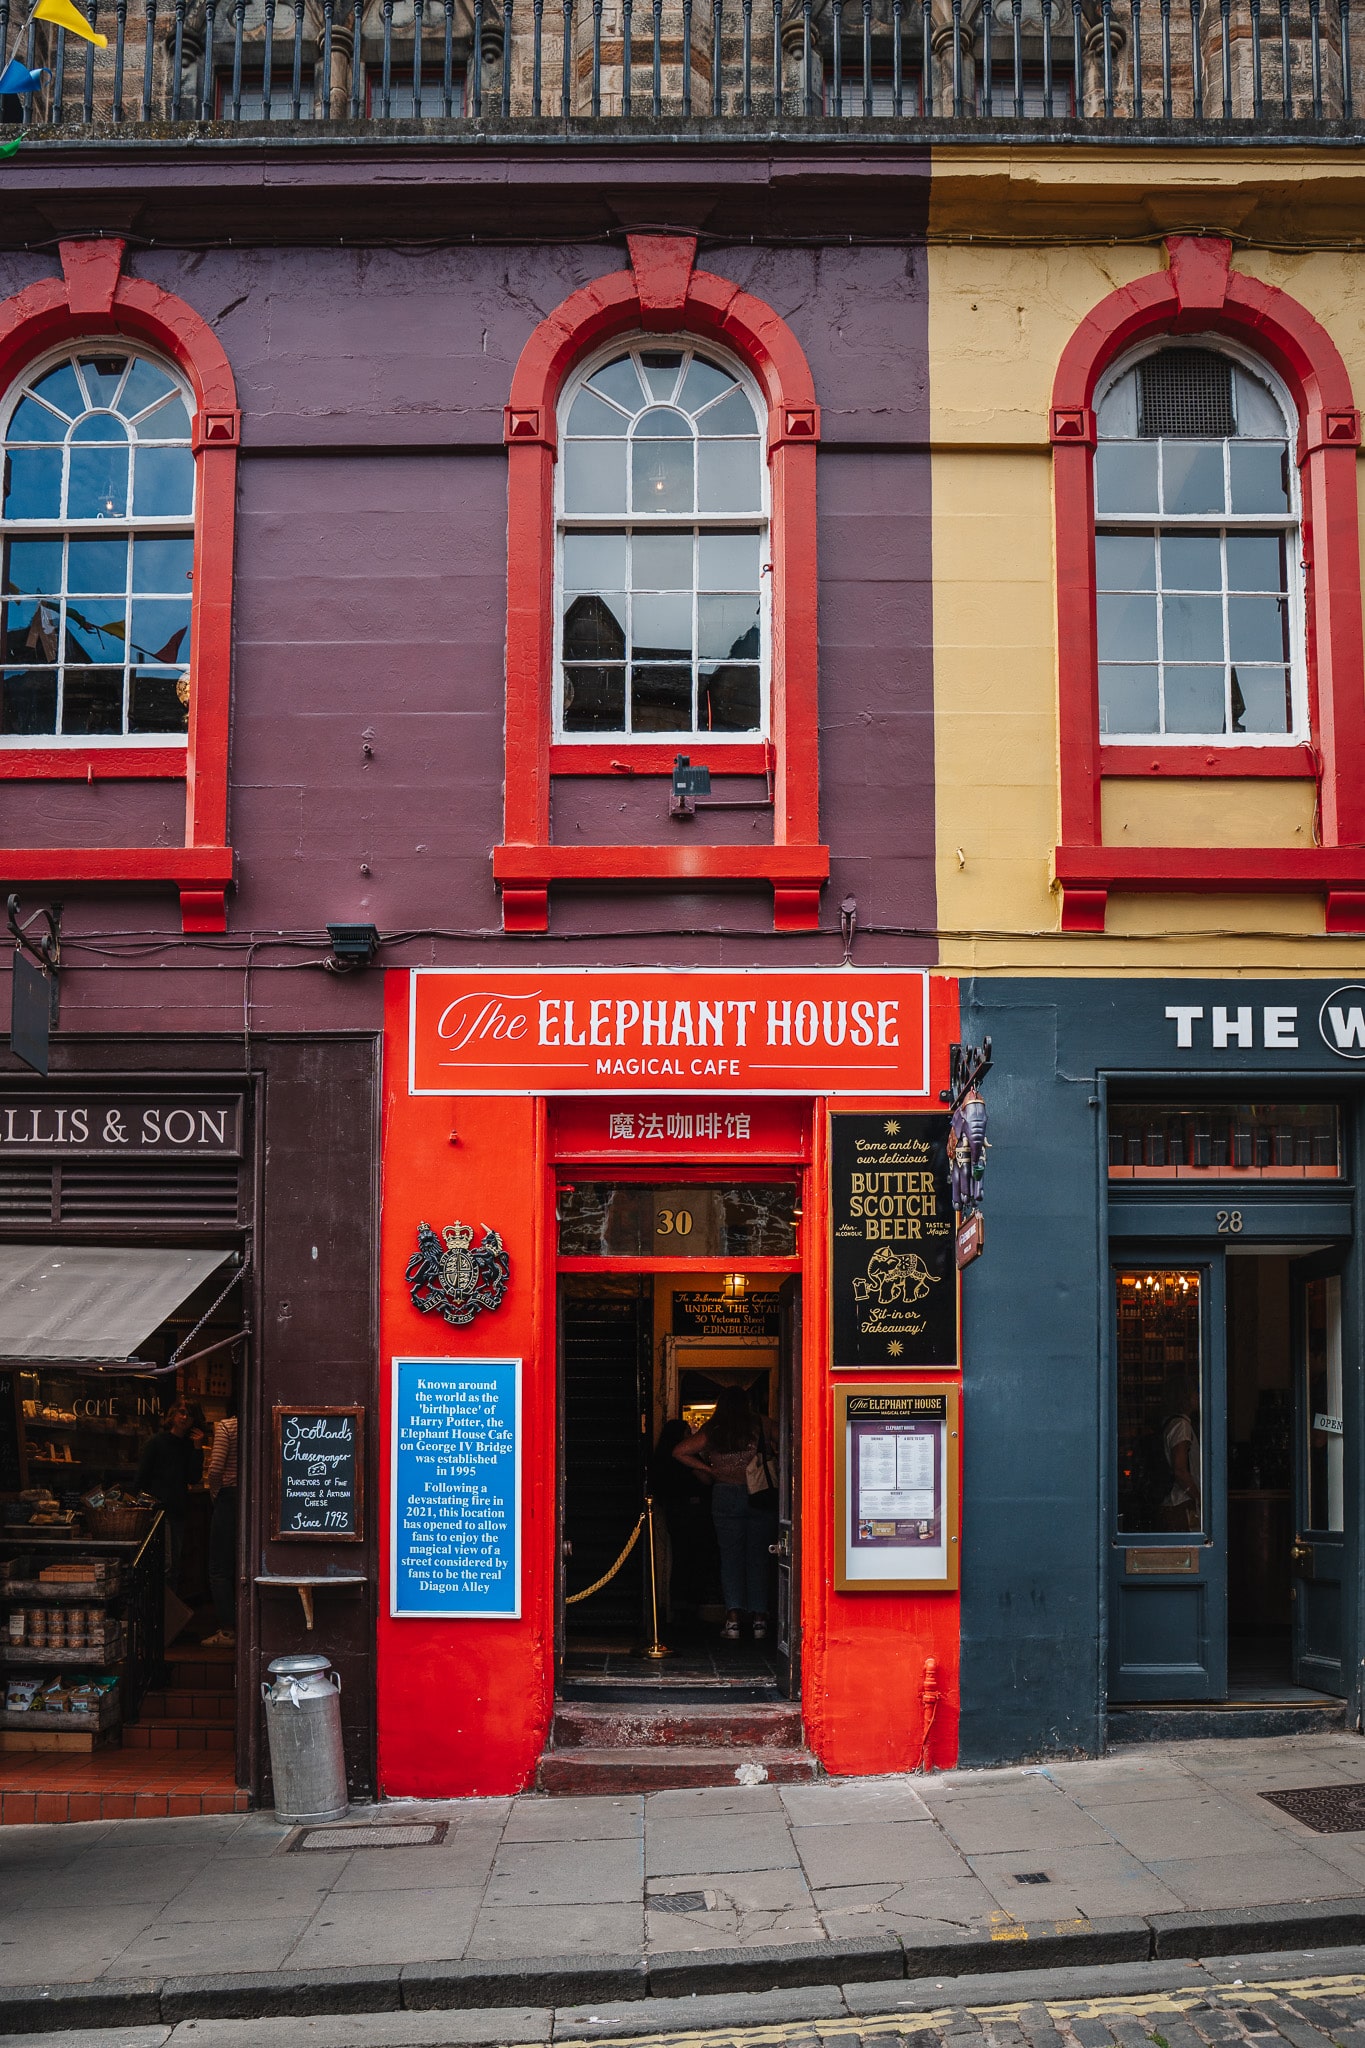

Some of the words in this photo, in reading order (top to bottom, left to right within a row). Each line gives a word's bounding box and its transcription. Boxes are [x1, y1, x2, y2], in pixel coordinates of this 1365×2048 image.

[438, 989, 542, 1052] The
[538, 999, 756, 1047] ELEPHANT
[766, 1001, 899, 1047] HOUSE
[1165, 1006, 1299, 1049] THE
[596, 1059, 685, 1075] MAGICAL
[690, 1059, 740, 1075] CAFE
[0, 1109, 89, 1143] LLIS
[103, 1109, 128, 1143] &
[141, 1109, 228, 1143] SON
[609, 1113, 751, 1139] 魔法咖啡馆
[855, 1139, 887, 1150] Come
[889, 1139, 910, 1150] and
[913, 1139, 930, 1152] try
[857, 1154, 878, 1164] our
[879, 1153, 928, 1164] delicious
[851, 1173, 935, 1194] BUTTER
[850, 1195, 936, 1217] SCOTCH
[656, 1209, 693, 1236] 30
[1216, 1210, 1243, 1233] 28
[866, 1219, 922, 1240] BEER
[685, 1304, 723, 1312] UNDER
[726, 1304, 749, 1313] THE
[752, 1303, 780, 1313] STAI
[694, 1315, 707, 1323] 30
[711, 1315, 740, 1323] Victoria
[744, 1314, 765, 1323] Street
[869, 1308, 903, 1322] Sit-in
[703, 1326, 765, 1334] EDINBURGH
[861, 1321, 927, 1334] Takeaway!
[418, 1379, 456, 1390] Known
[459, 1381, 497, 1390] around
[416, 1393, 433, 1401] the
[435, 1393, 466, 1402] world
[482, 1393, 498, 1402] the
[73, 1398, 119, 1417] COME
[137, 1396, 165, 1416] IN!
[419, 1405, 481, 1416] 'birthplace'
[484, 1405, 496, 1415] of
[850, 1398, 870, 1411] The
[869, 1399, 913, 1409] ELEPHANT
[915, 1399, 941, 1409] HOUSE
[410, 1417, 444, 1428] Harry
[446, 1417, 484, 1428] Potter,
[487, 1418, 503, 1427] the
[1320, 1418, 1343, 1430] OPEN
[287, 1417, 352, 1441] Scotland's
[401, 1429, 449, 1440] Elephant
[452, 1429, 486, 1440] House
[488, 1430, 513, 1440] Cafe
[400, 1443, 413, 1451] on
[416, 1442, 457, 1453] George
[459, 1442, 473, 1451] IV
[476, 1442, 512, 1453] Bridge
[283, 1440, 351, 1468] Cheesemonger
[438, 1454, 497, 1464] established
[437, 1466, 447, 1476] in
[450, 1467, 476, 1476] 1995
[424, 1482, 478, 1494] Following
[408, 1495, 469, 1506] devastating
[472, 1495, 490, 1505] fire
[493, 1496, 503, 1505] in
[406, 1507, 437, 1518] 2021,
[439, 1508, 458, 1518] this
[461, 1508, 504, 1519] location
[291, 1512, 321, 1530] Since
[324, 1511, 348, 1528] 1993
[404, 1520, 421, 1529] has
[424, 1520, 462, 1531] opened
[465, 1521, 475, 1530] to
[478, 1521, 507, 1530] allow
[412, 1532, 434, 1542] fans
[436, 1533, 447, 1542] to
[450, 1533, 479, 1545] enjoy
[482, 1533, 498, 1543] the
[409, 1545, 451, 1556] magical
[454, 1545, 479, 1554] view
[481, 1545, 493, 1555] of
[401, 1557, 432, 1567] street
[434, 1557, 492, 1568] considered
[495, 1558, 508, 1569] by
[409, 1569, 430, 1579] fans
[433, 1570, 443, 1579] to
[446, 1569, 458, 1579] be
[461, 1569, 477, 1579] the
[480, 1570, 501, 1580] real
[420, 1581, 458, 1594] Diagon
[462, 1582, 489, 1593] Alley
